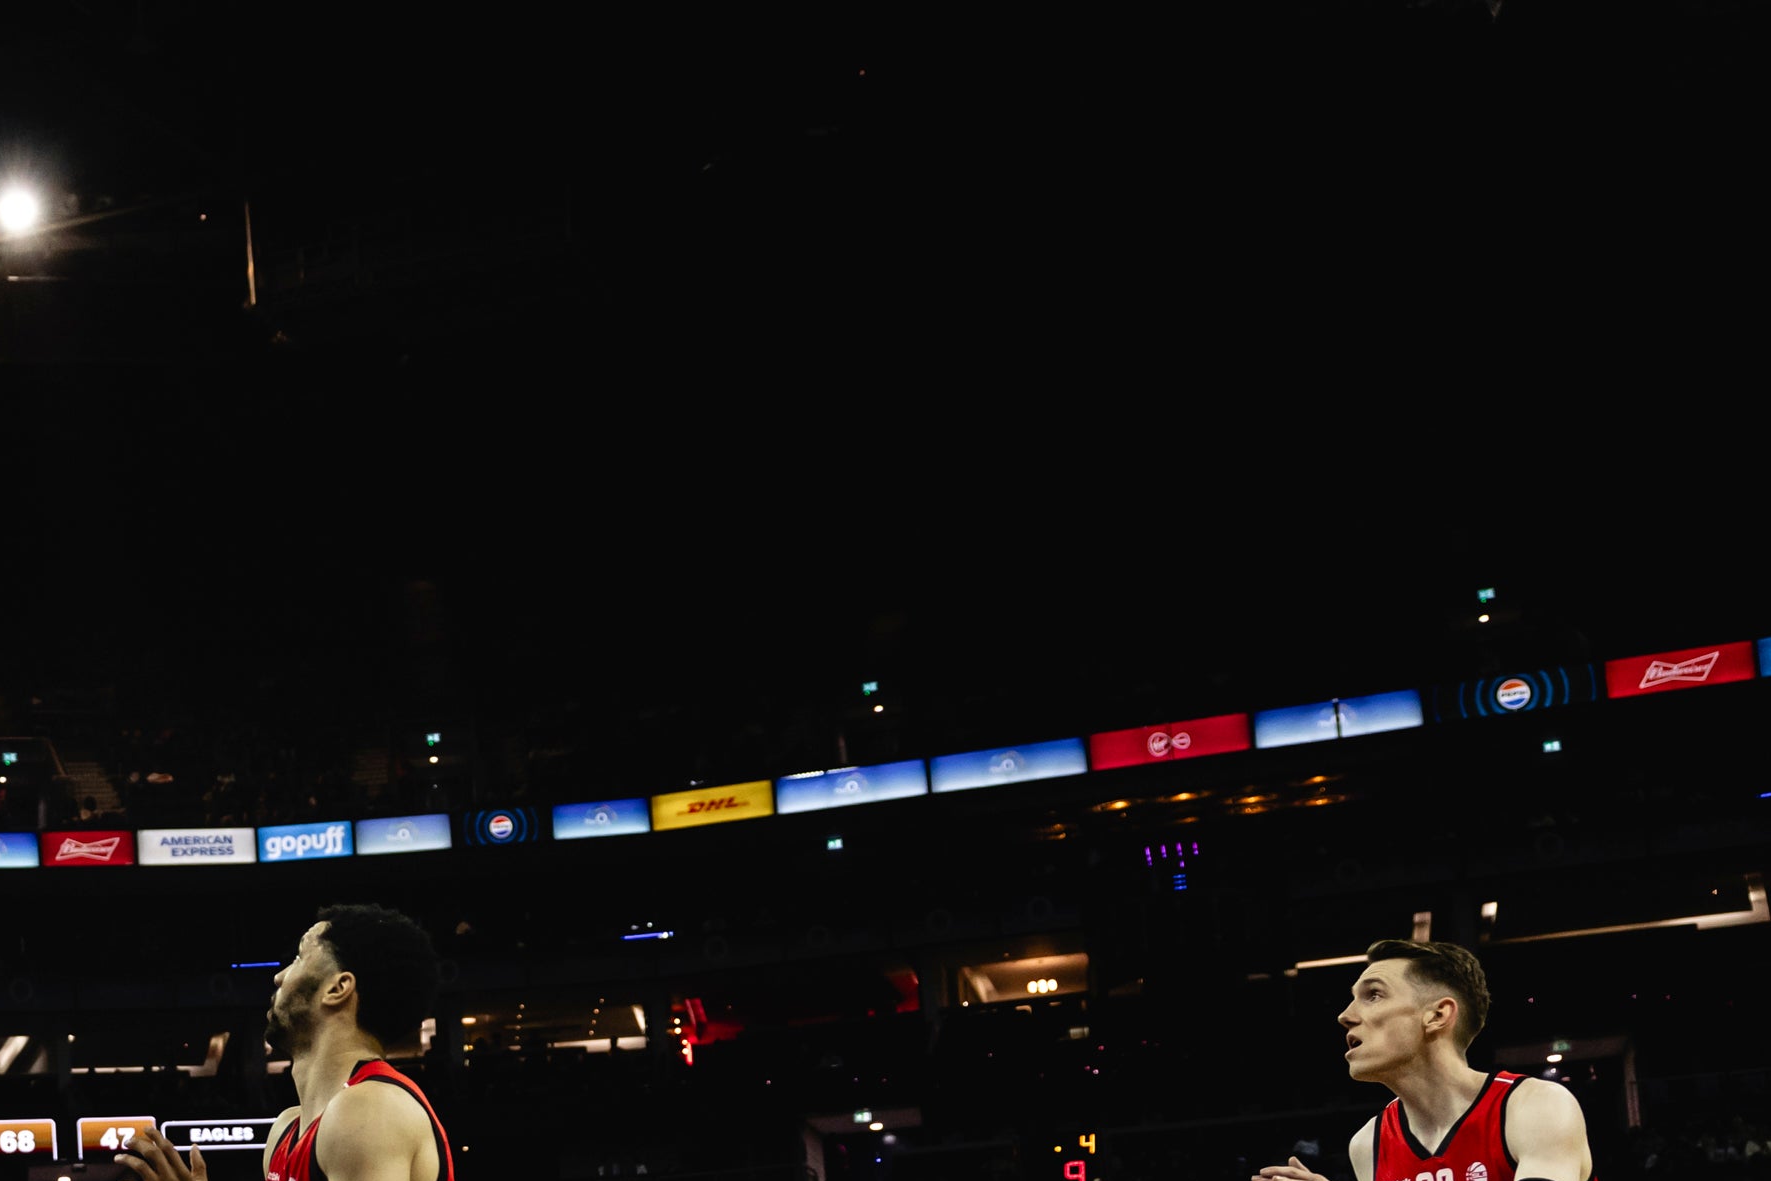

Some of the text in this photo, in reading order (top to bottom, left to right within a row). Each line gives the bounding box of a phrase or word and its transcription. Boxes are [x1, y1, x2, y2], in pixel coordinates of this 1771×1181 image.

[160, 835, 233, 847] AMERICAN
[171, 845, 235, 857] EXPRESS
[266, 825, 346, 858] gopuff
[0, 1130, 36, 1153] 68
[100, 1127, 135, 1149] 47
[190, 1127, 254, 1142] EAGLES
[1079, 1133, 1096, 1154] 4
